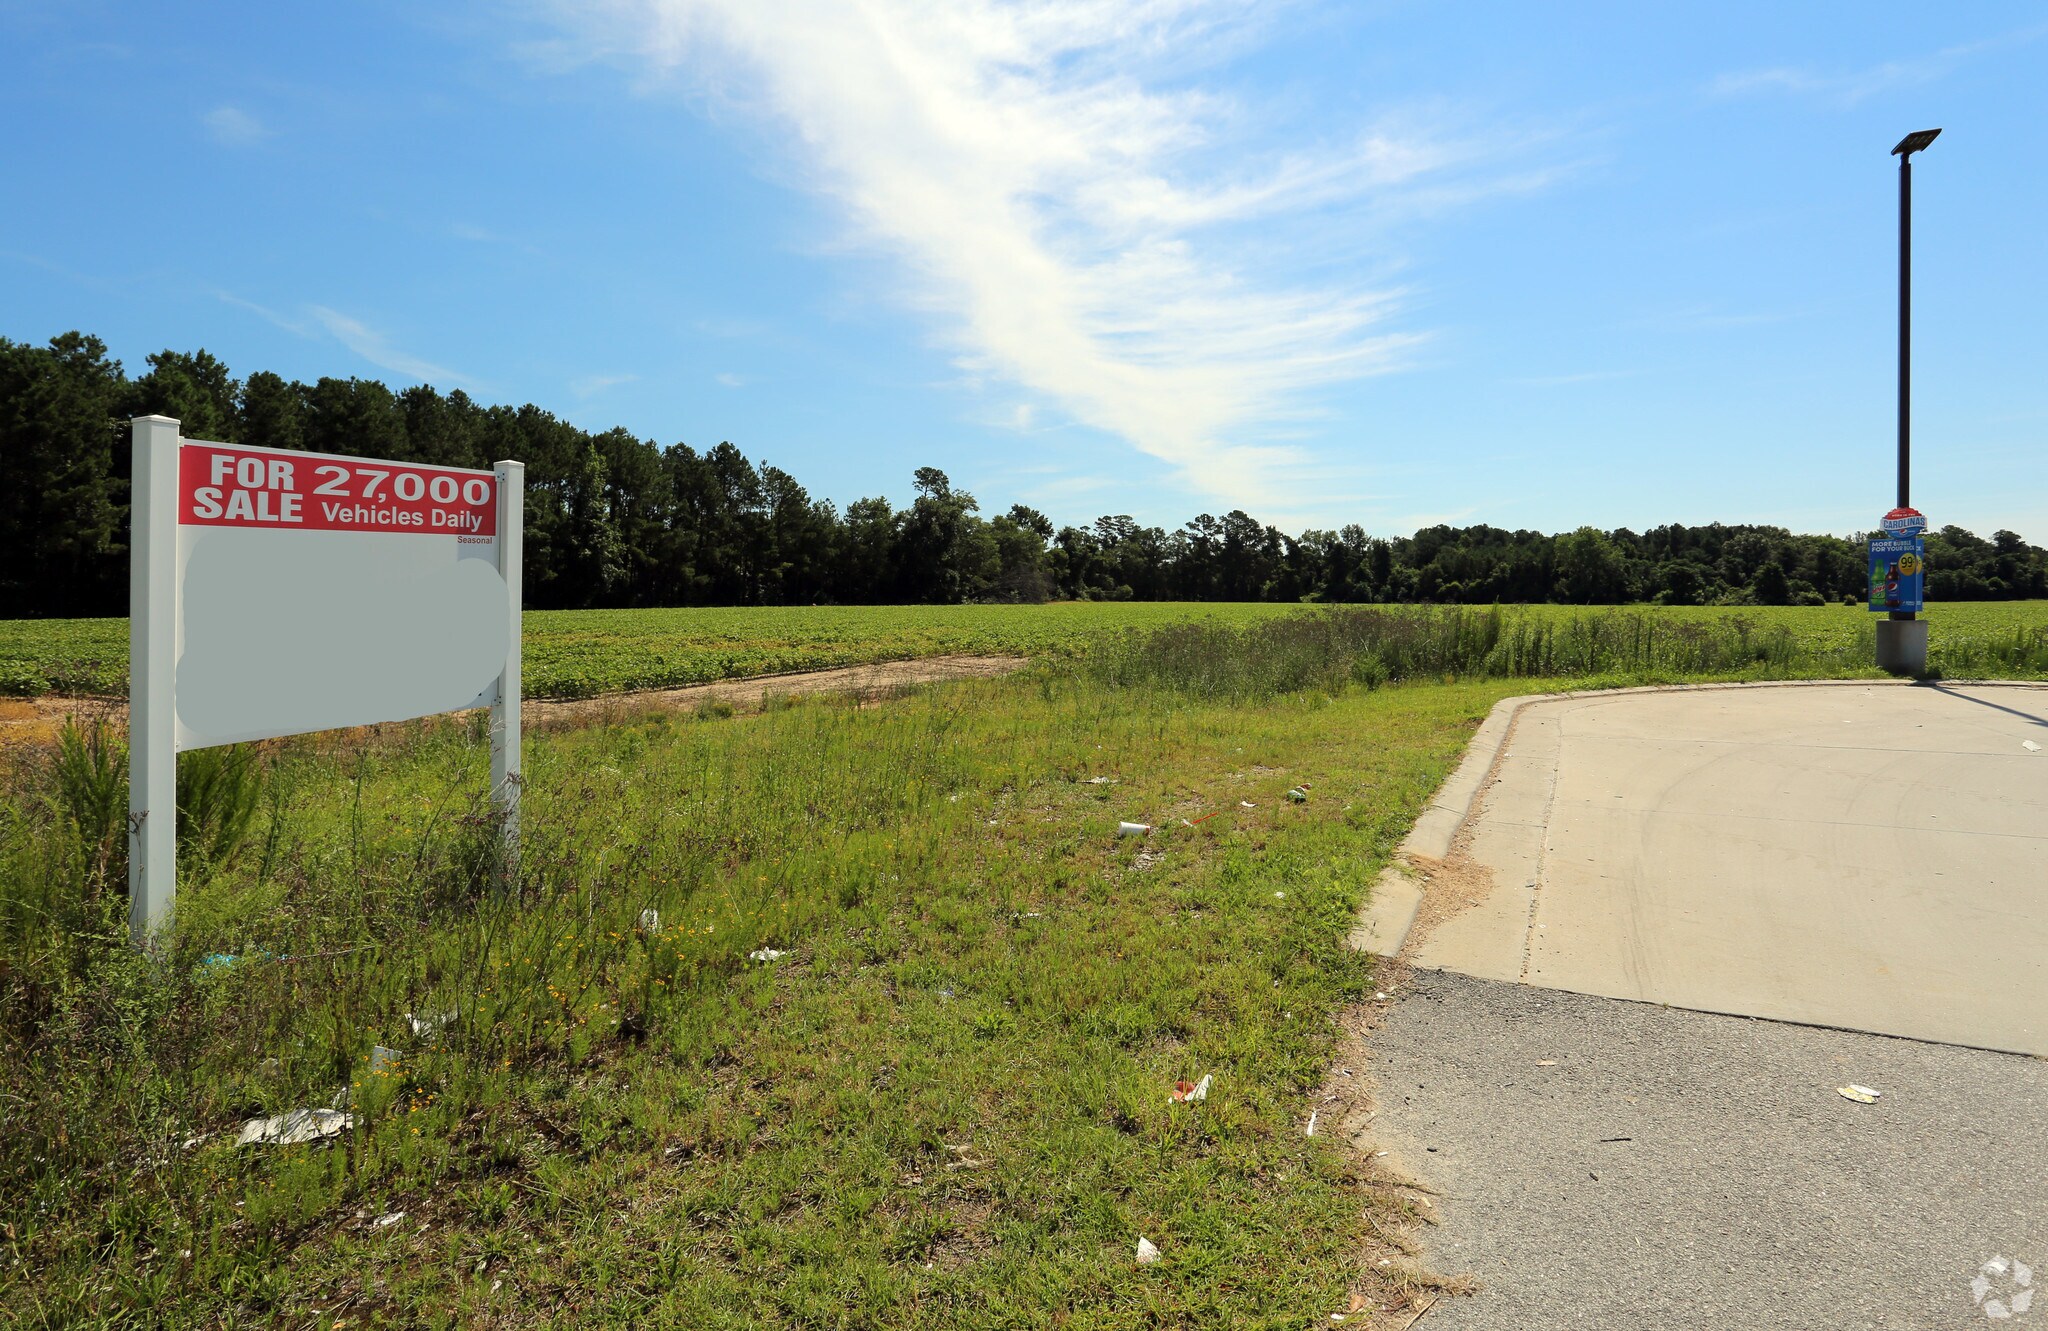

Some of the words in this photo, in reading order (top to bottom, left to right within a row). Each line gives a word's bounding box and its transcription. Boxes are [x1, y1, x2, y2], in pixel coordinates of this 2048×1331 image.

[211, 454, 294, 491] FOR
[313, 466, 490, 505] 27,000
[193, 486, 303, 522] SALE
[321, 502, 424, 526] Vehicles
[431, 509, 482, 532] Daily
[1883, 517, 1926, 528] CAROLINAS
[457, 536, 492, 544] Seasonal
